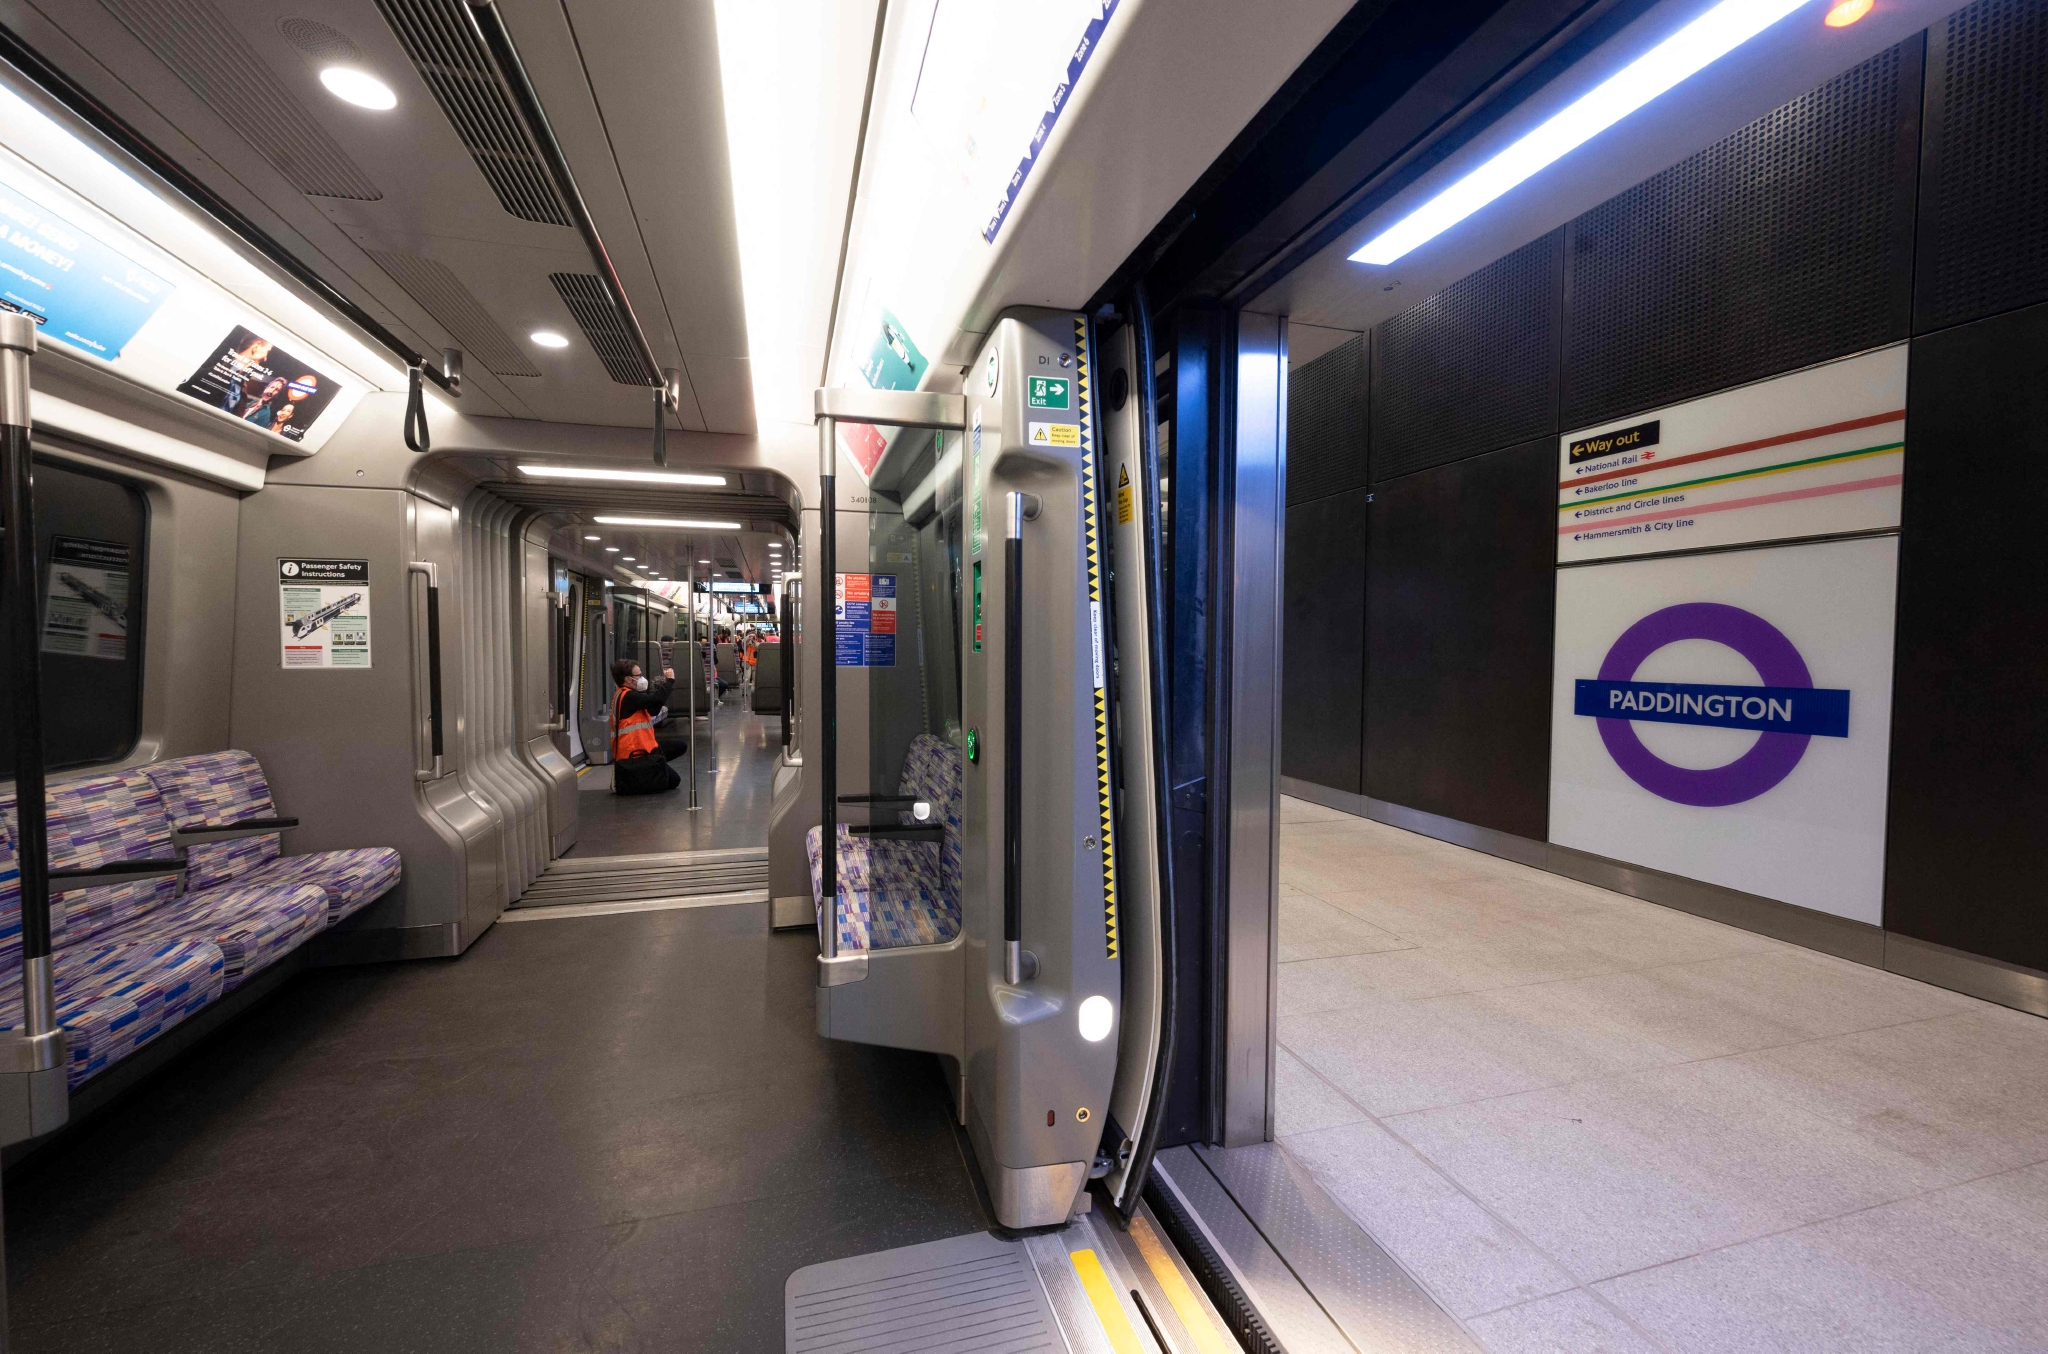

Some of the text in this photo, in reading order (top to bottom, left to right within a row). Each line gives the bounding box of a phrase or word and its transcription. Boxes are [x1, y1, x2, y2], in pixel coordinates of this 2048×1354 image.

[1075, 36, 1090, 62] Zone 6
[1052, 83, 1066, 106] Zone 5
[1034, 127, 1044, 143] Zone
[1011, 172, 1020, 186] Zone
[8, 230, 76, 272] MONEY!
[222, 354, 232, 363] for
[1031, 397, 1046, 406] Exit
[1586, 432, 1640, 454] Way out
[1585, 455, 1638, 473] National Rail
[1584, 478, 1638, 494] Bakerloo line
[1584, 495, 1685, 517] District and Circle lines
[1584, 519, 1694, 540] Hammersmith & City line
[301, 562, 337, 570] Passenger
[1609, 690, 1792, 722] PADDINGTON
